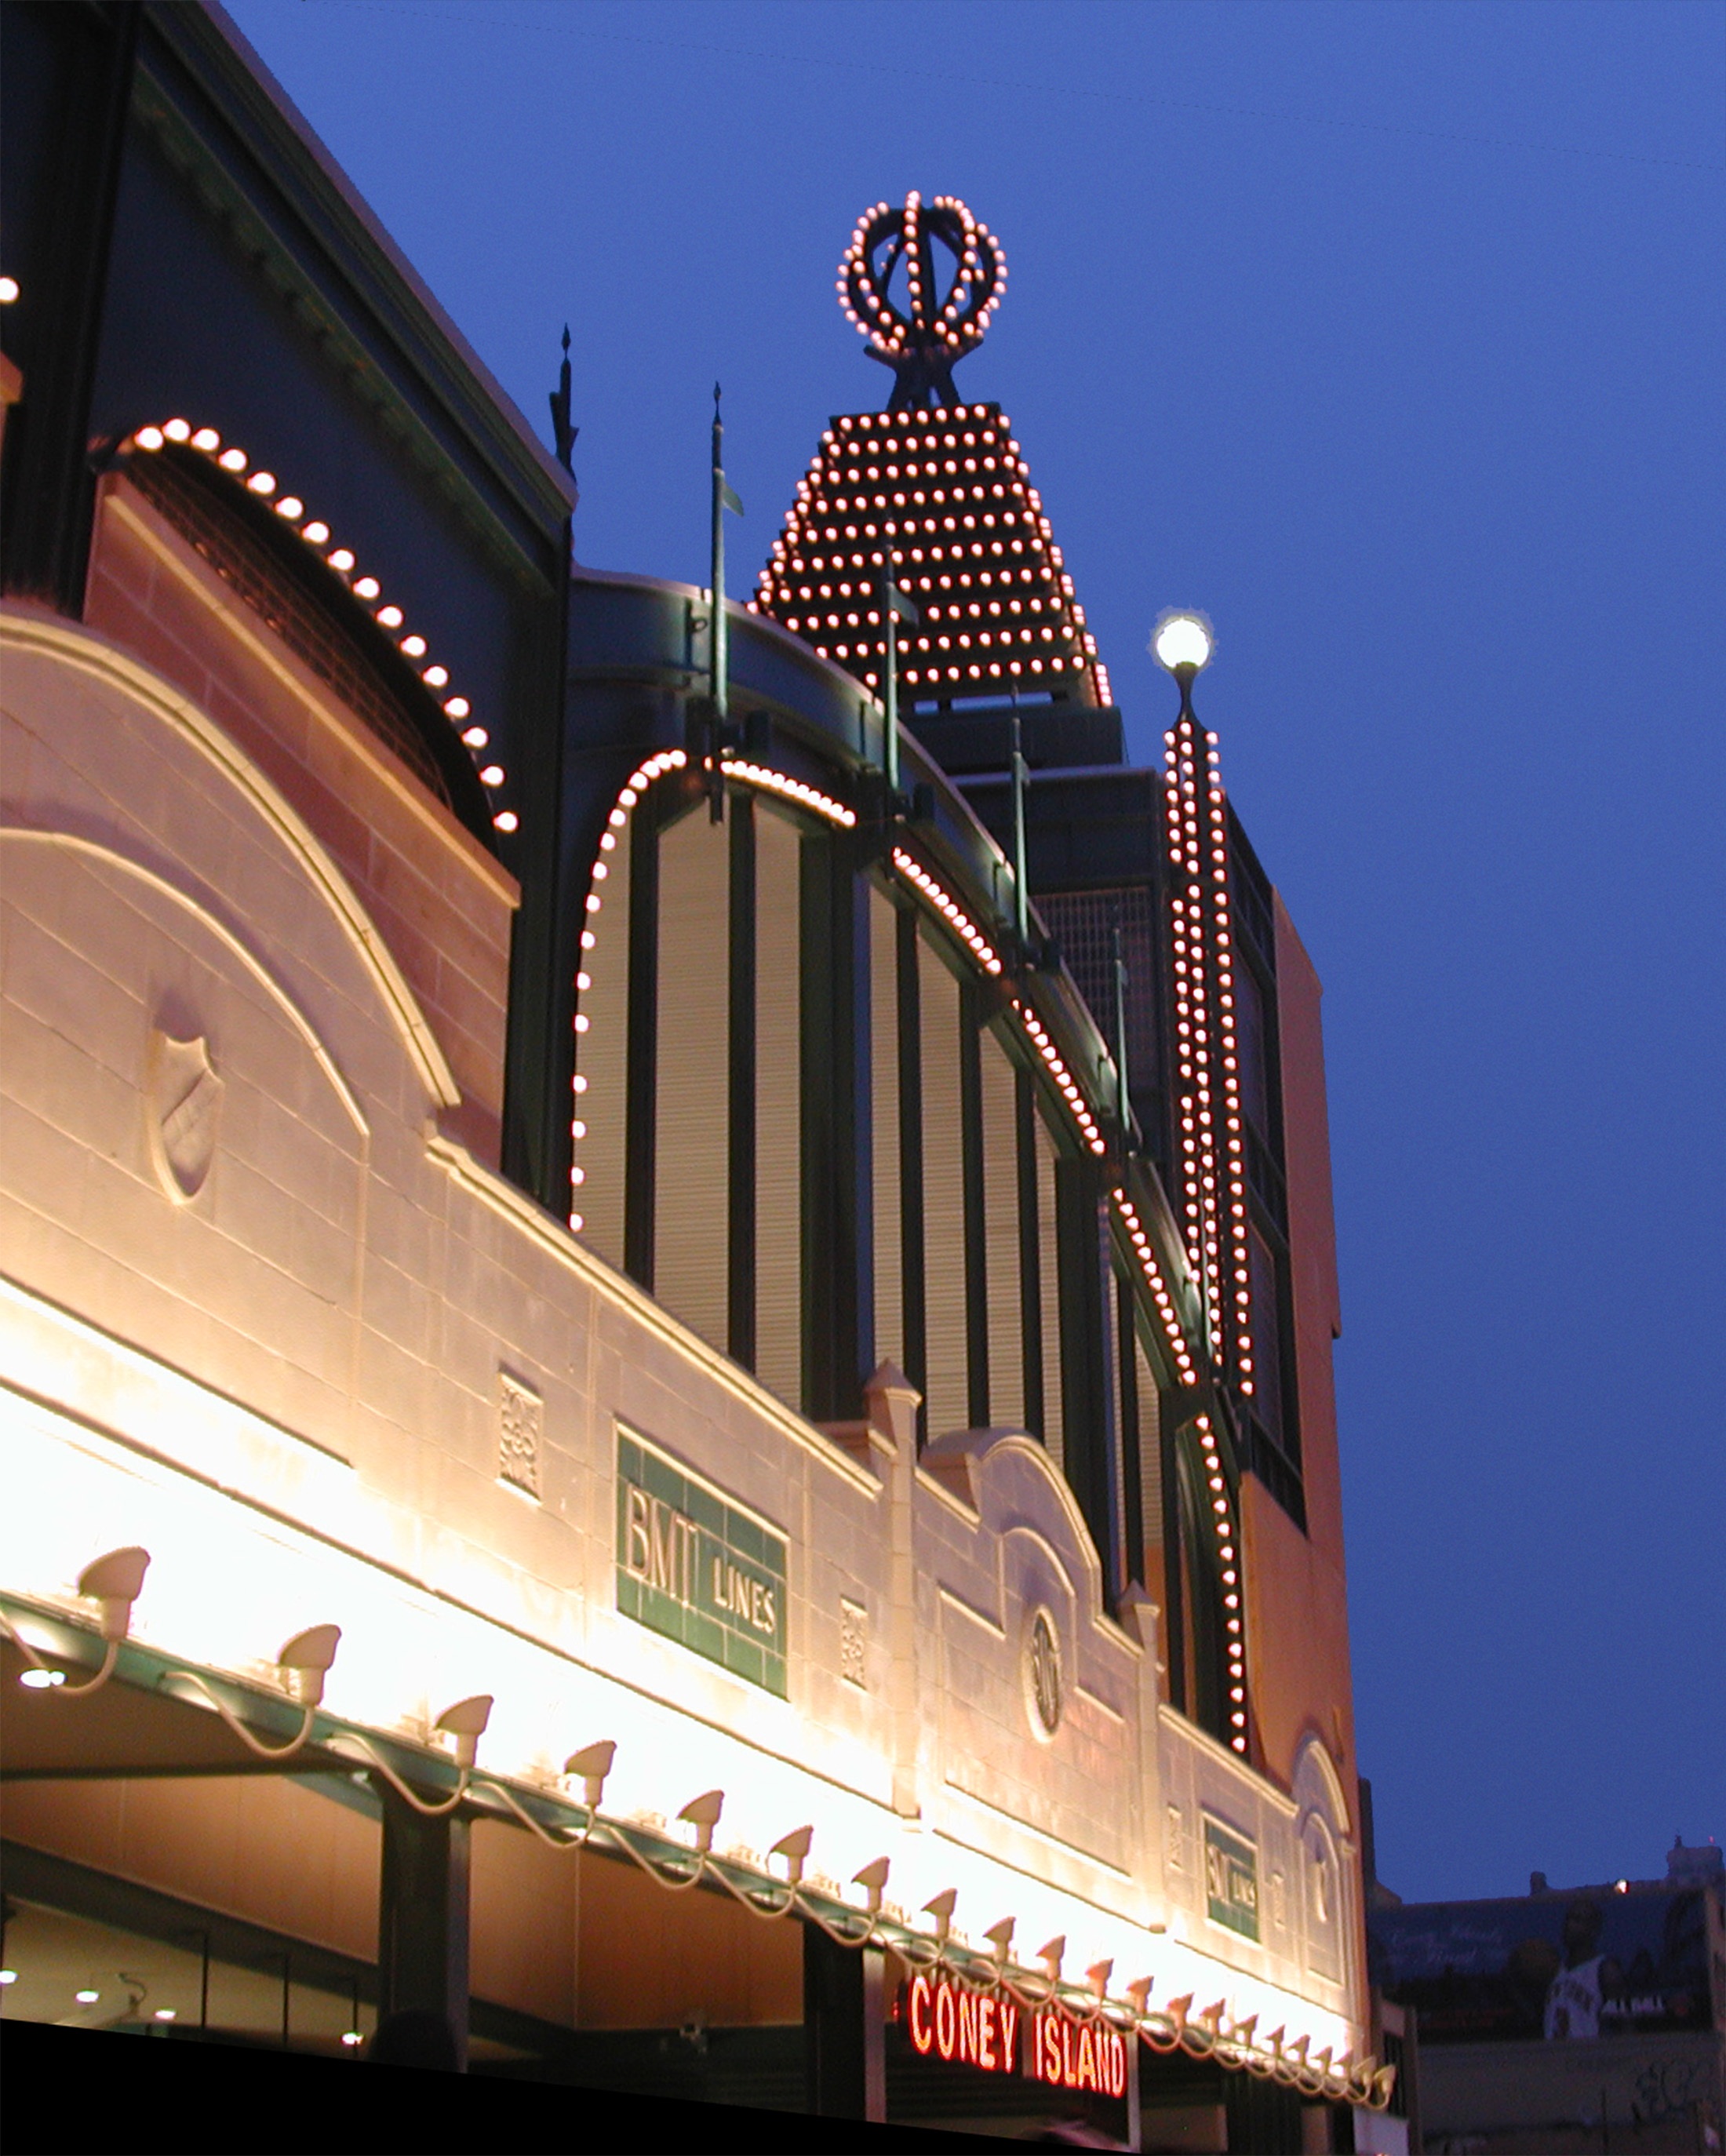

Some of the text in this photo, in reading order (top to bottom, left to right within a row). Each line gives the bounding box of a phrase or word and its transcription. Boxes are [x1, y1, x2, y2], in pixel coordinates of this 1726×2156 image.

[628, 1486, 776, 1633] BMT LINES
[909, 1976, 1126, 2098] CONEY ISLAND
